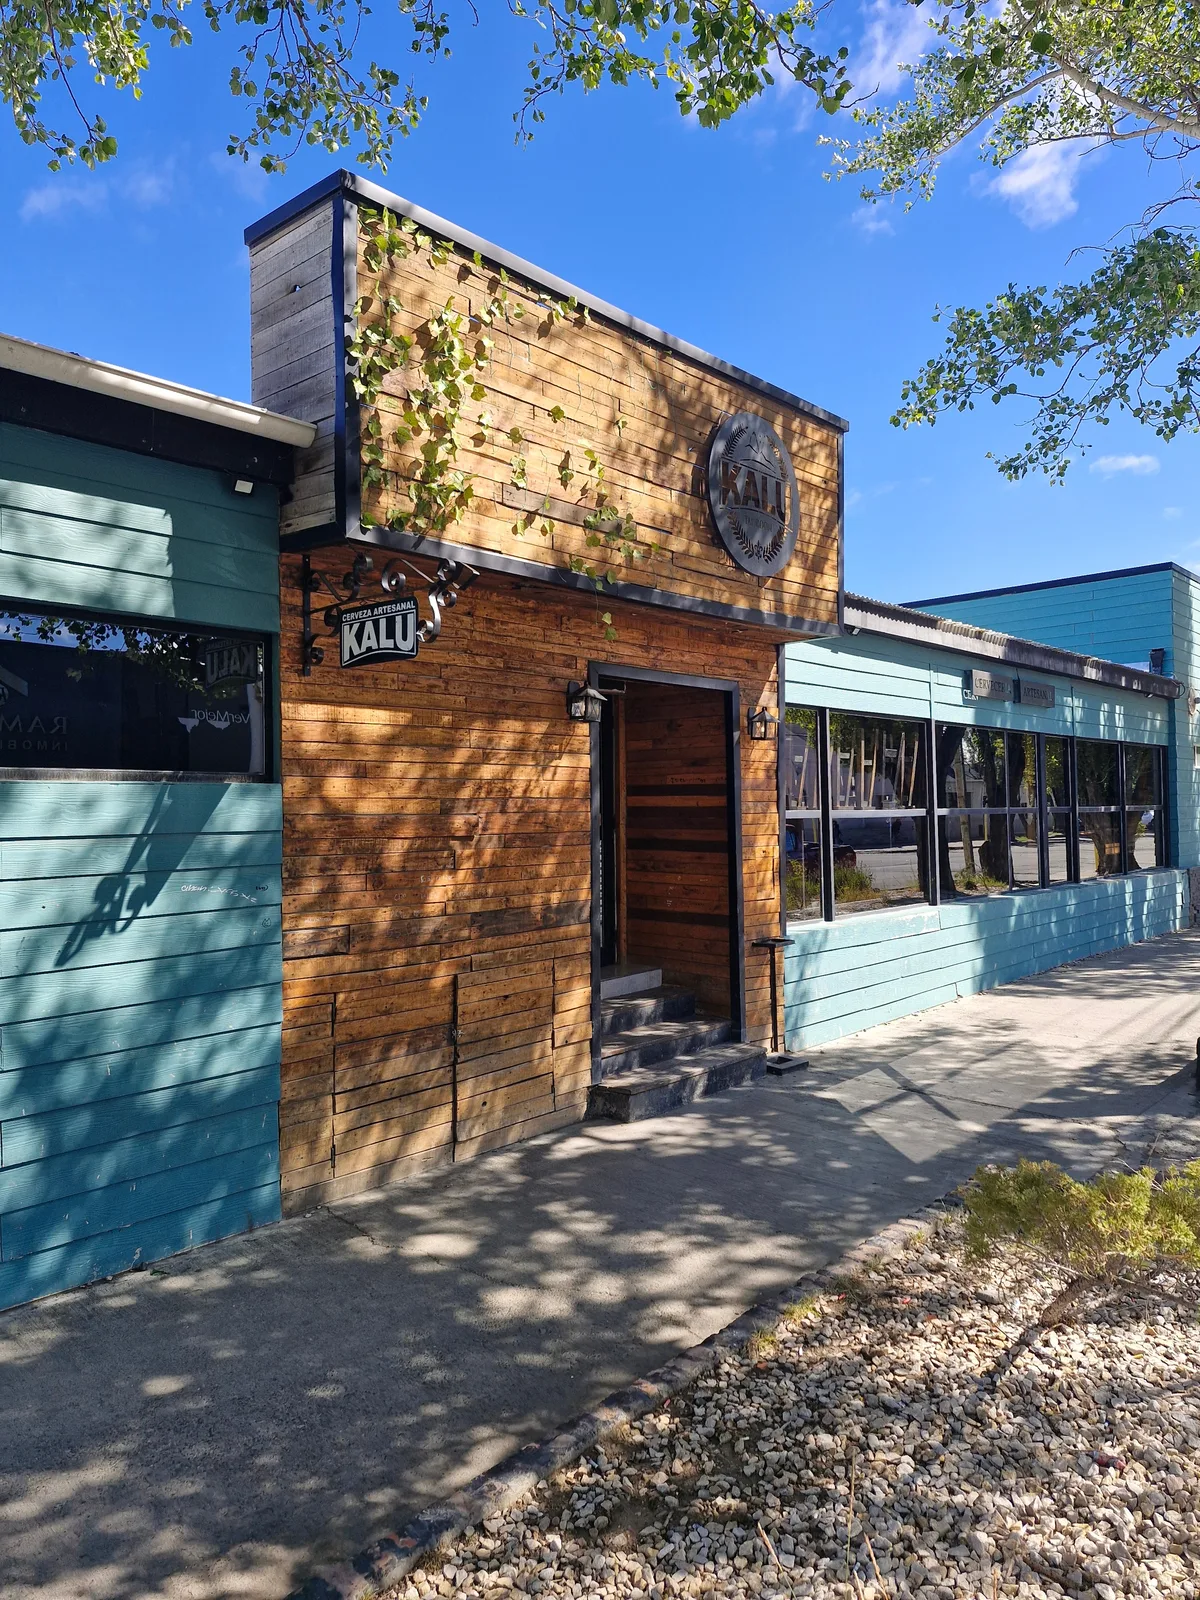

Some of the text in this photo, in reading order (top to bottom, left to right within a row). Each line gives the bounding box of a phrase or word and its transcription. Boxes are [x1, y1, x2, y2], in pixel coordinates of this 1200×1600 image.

[721, 461, 792, 527] KALU
[342, 600, 416, 622] CERVEZA ARTESANAL
[343, 613, 414, 662] KALU
[1023, 687, 1054, 702] ARTESANAL
